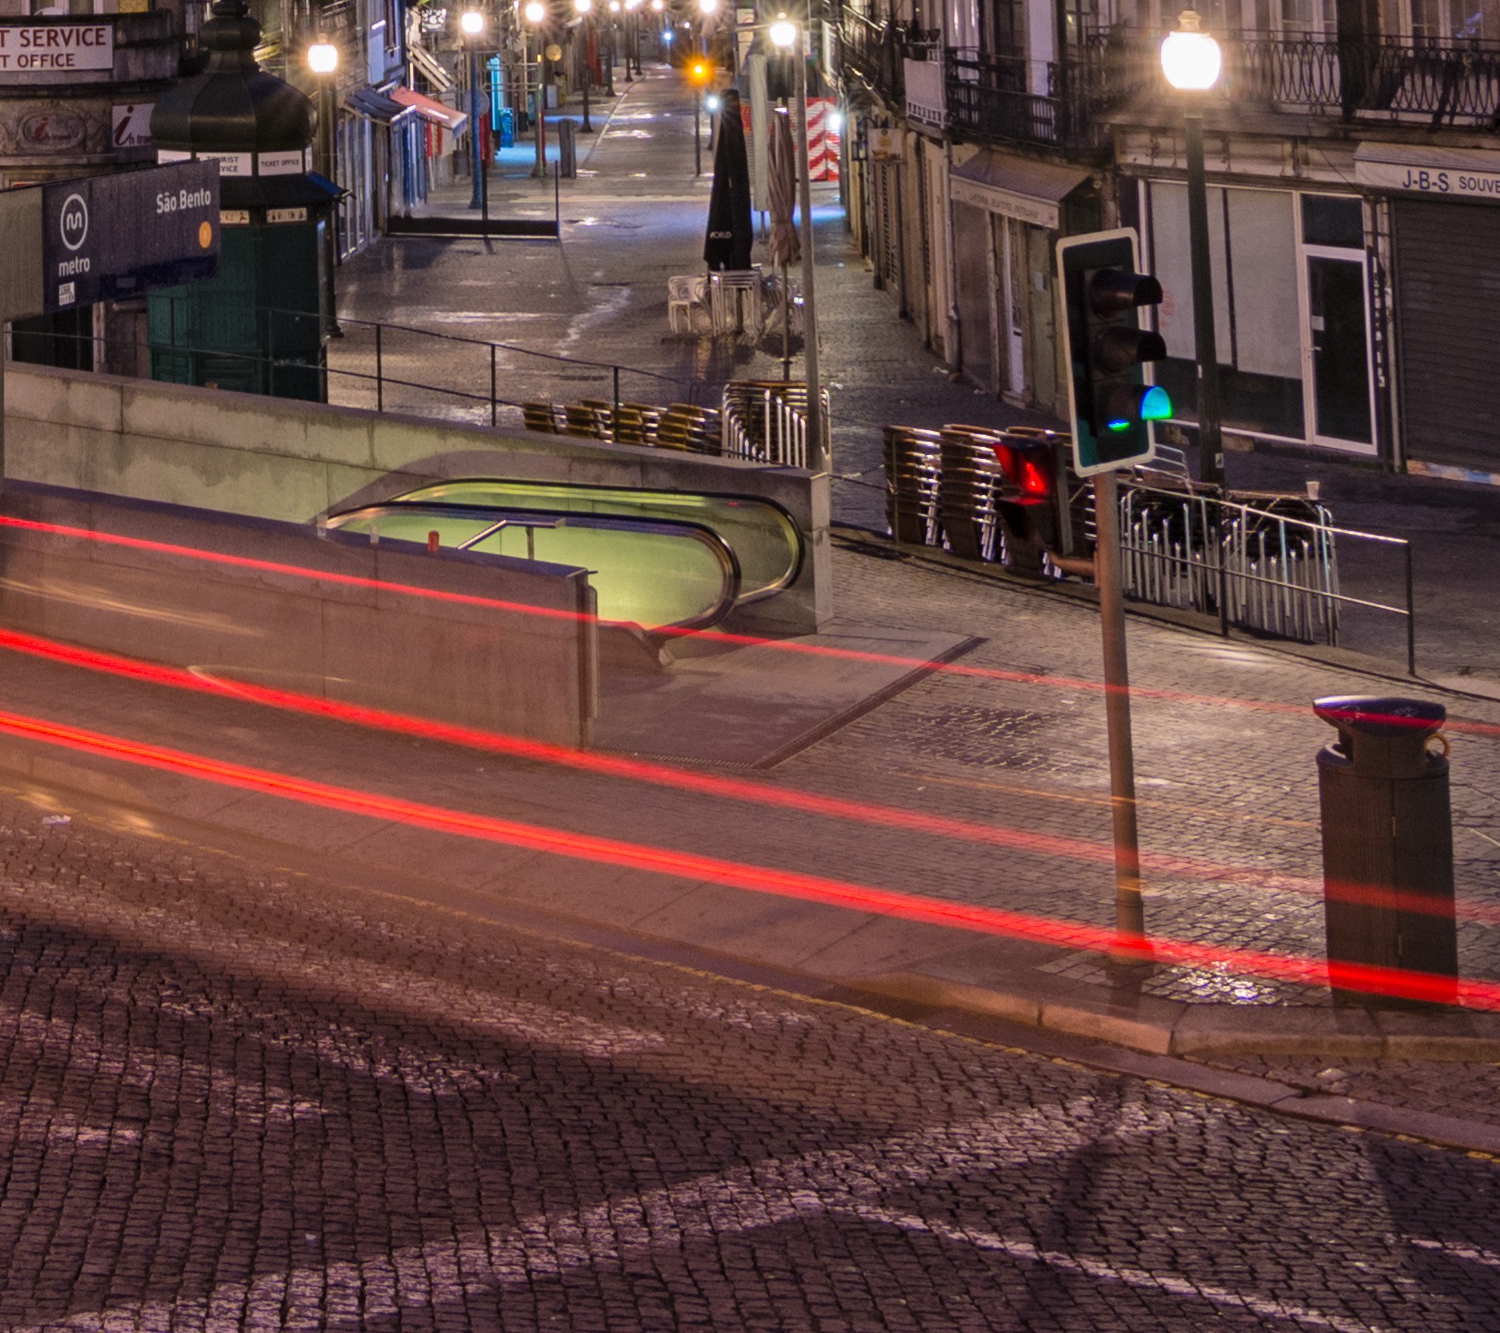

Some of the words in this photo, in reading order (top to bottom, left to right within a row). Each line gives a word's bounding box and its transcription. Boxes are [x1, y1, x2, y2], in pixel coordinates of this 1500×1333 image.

[19, 27, 107, 48] SERVICE
[17, 53, 76, 68] OFFICE
[1402, 170, 1450, 192] J-B-S
[156, 191, 176, 214] São
[179, 188, 212, 210] Bento
[58, 256, 90, 276] metro
